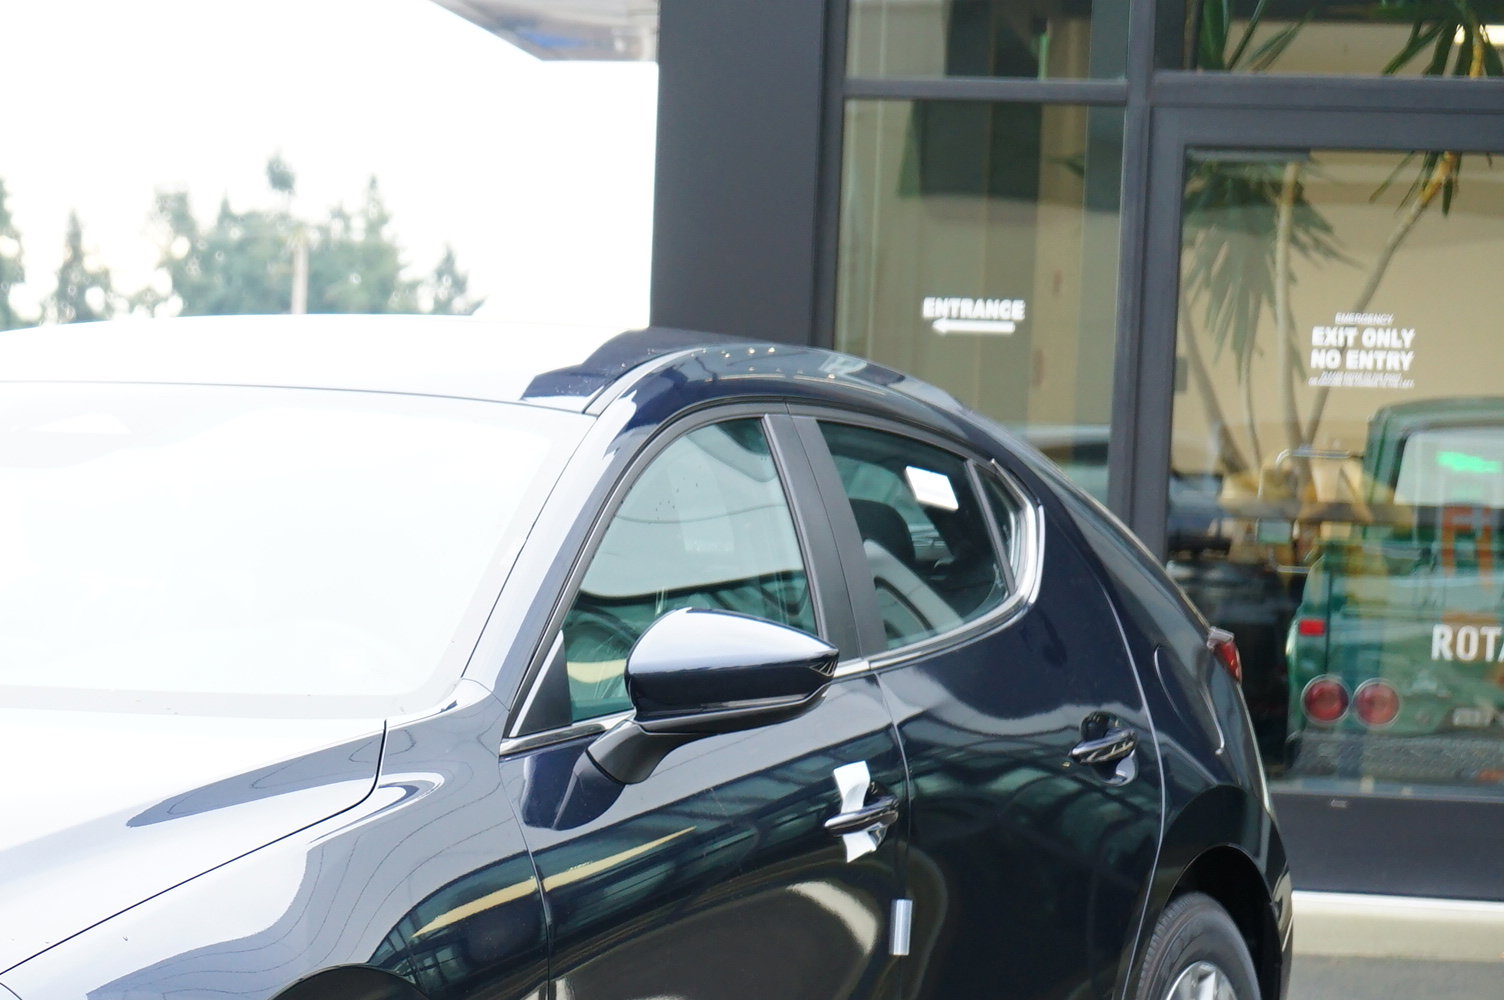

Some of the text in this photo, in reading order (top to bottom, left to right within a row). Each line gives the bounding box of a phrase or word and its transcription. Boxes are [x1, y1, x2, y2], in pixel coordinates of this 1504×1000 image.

[922, 296, 1026, 321] ENTRANCE
[1311, 326, 1416, 349] EXIT ONLY
[1310, 349, 1416, 371] NO ENTRY
[1431, 624, 1504, 662] ROT
